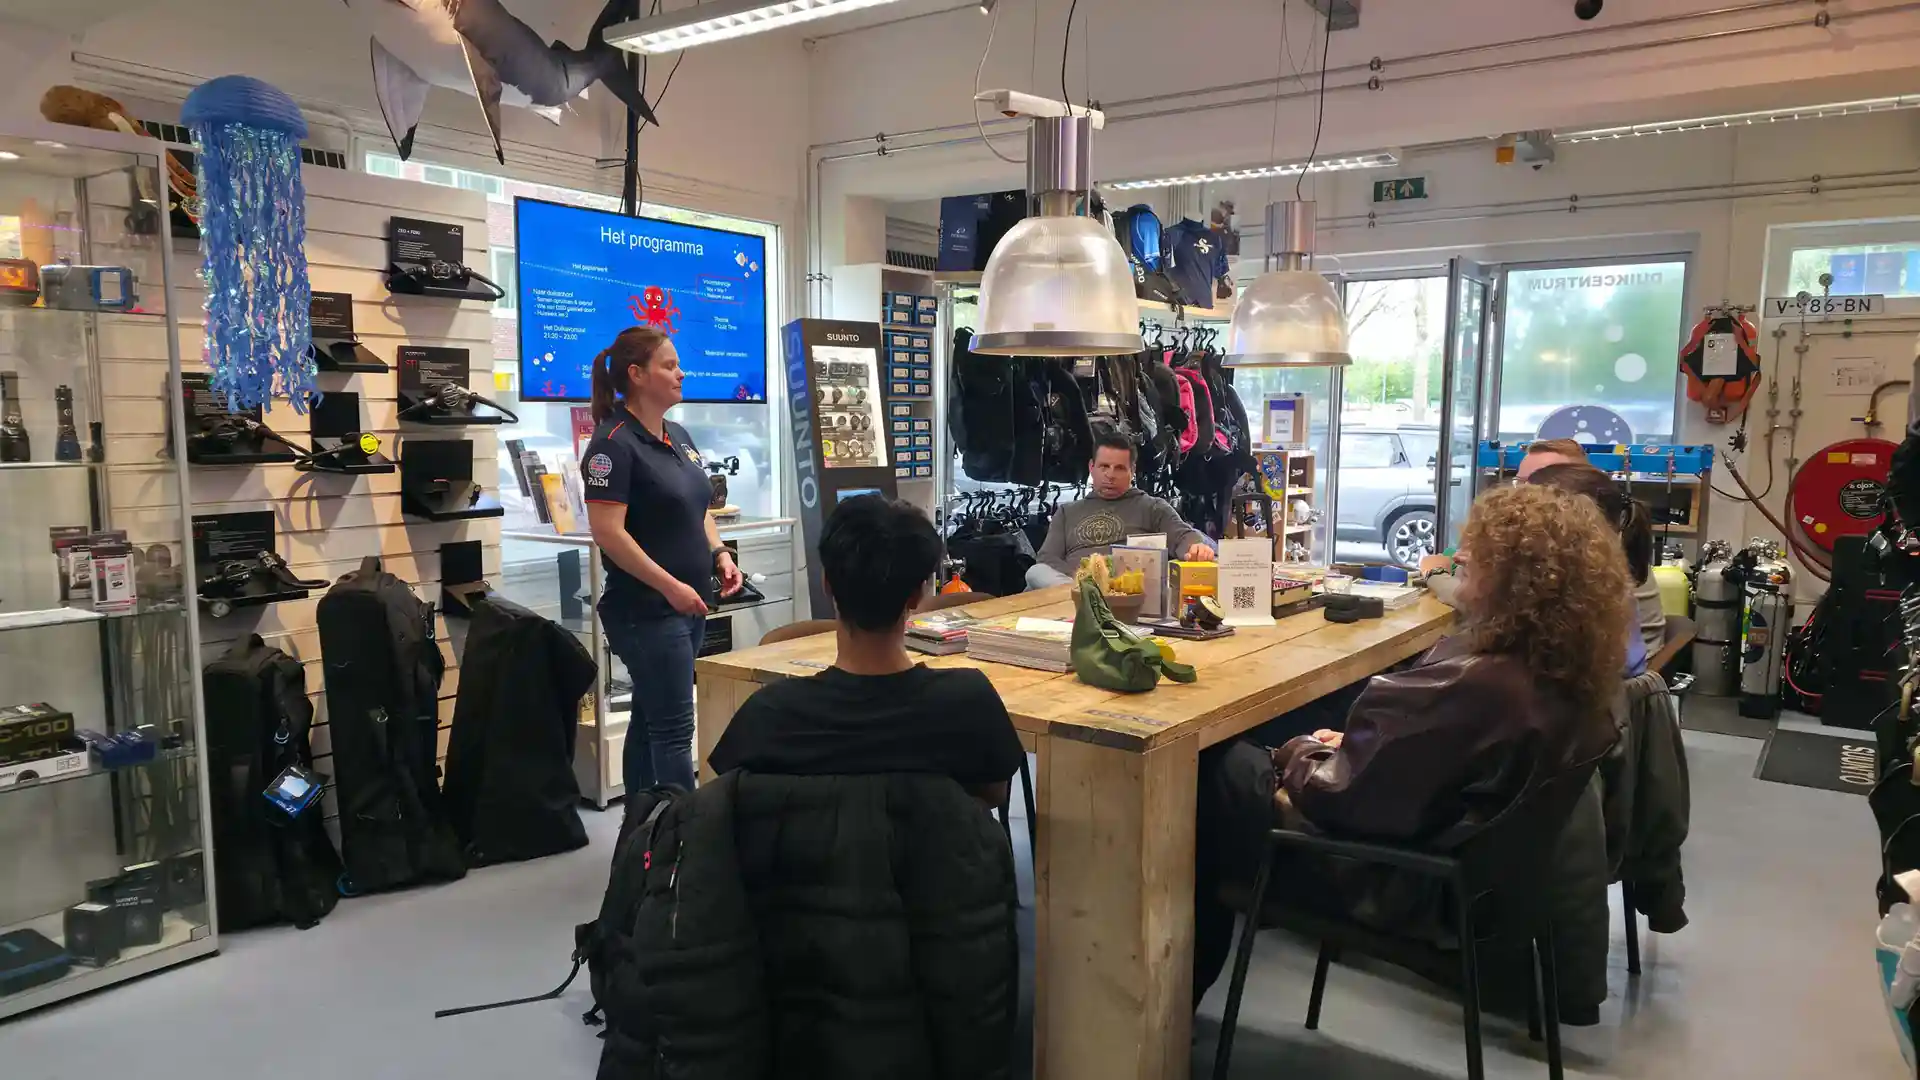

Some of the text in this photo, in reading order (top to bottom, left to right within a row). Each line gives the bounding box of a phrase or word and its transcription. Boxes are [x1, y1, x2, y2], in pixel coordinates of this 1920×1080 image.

[600, 225, 704, 256] Het programma
[826, 333, 860, 342] SUUNTO
[788, 331, 817, 509] SUUNTO
[588, 477, 609, 487] PADI
[1839, 744, 1876, 785] SUUNTO
